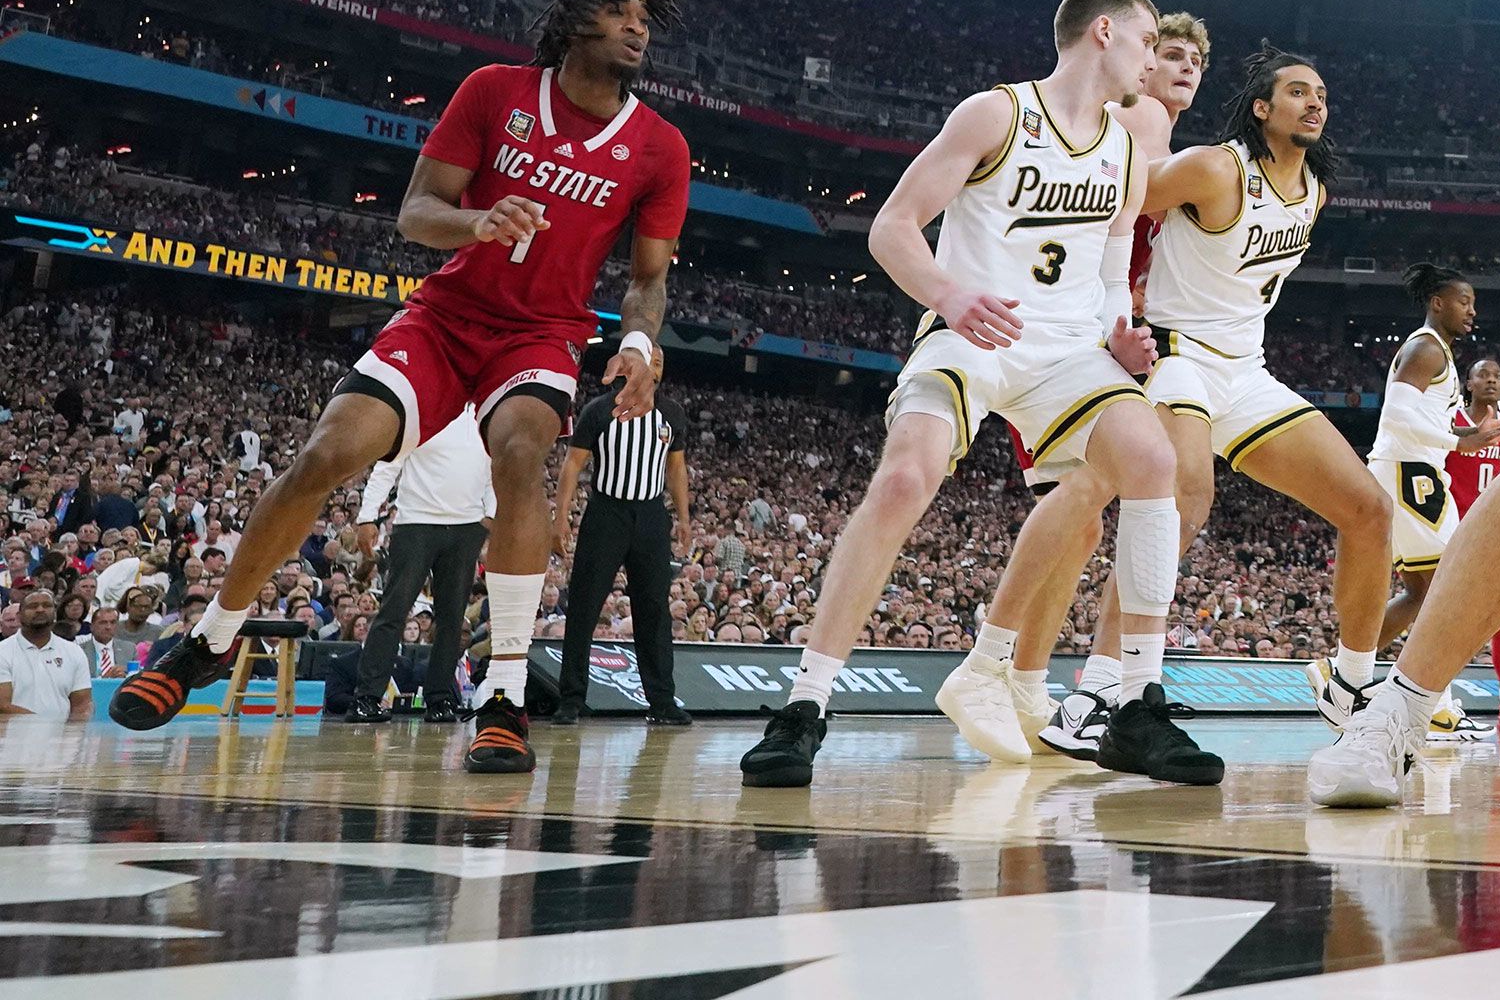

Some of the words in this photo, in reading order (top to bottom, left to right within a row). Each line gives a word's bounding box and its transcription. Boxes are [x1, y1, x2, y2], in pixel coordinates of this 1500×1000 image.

[699, 94, 740, 115] TRIPPI
[364, 115, 408, 140] THE
[493, 144, 534, 179] NC
[529, 160, 618, 207] STATE
[1007, 165, 1117, 214] Purdue
[1329, 196, 1379, 209] ADRIAN
[1381, 199, 1431, 211] WILSON
[123, 232, 196, 269] AND
[205, 244, 287, 283] THEN
[296, 259, 388, 299] THERE
[1031, 240, 1067, 286] 3
[1259, 272, 1280, 304] 4
[1411, 475, 1435, 505] P
[1477, 463, 1495, 494] 0
[702, 663, 784, 692] NC
